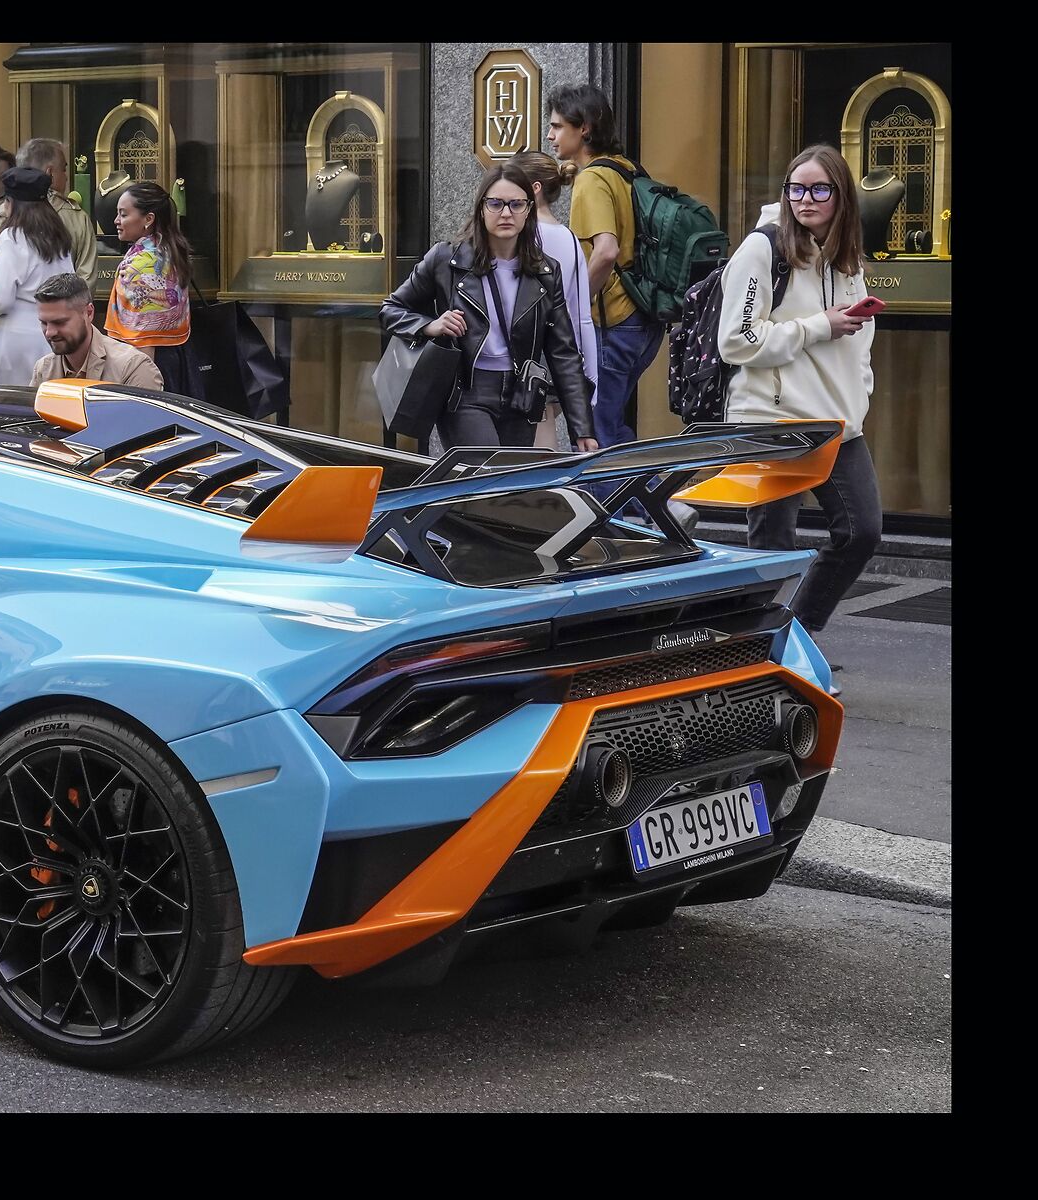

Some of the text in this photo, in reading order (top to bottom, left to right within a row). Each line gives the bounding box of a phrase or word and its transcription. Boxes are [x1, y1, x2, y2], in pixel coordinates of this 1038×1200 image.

[97, 270, 116, 278] INST
[274, 272, 347, 282] HARRY WINSTON
[865, 276, 902, 288] NSTON
[656, 630, 711, 650] Lamborghini
[24, 722, 70, 738] POTENZA
[683, 848, 735, 870] LAMBORGHINI MILANO
